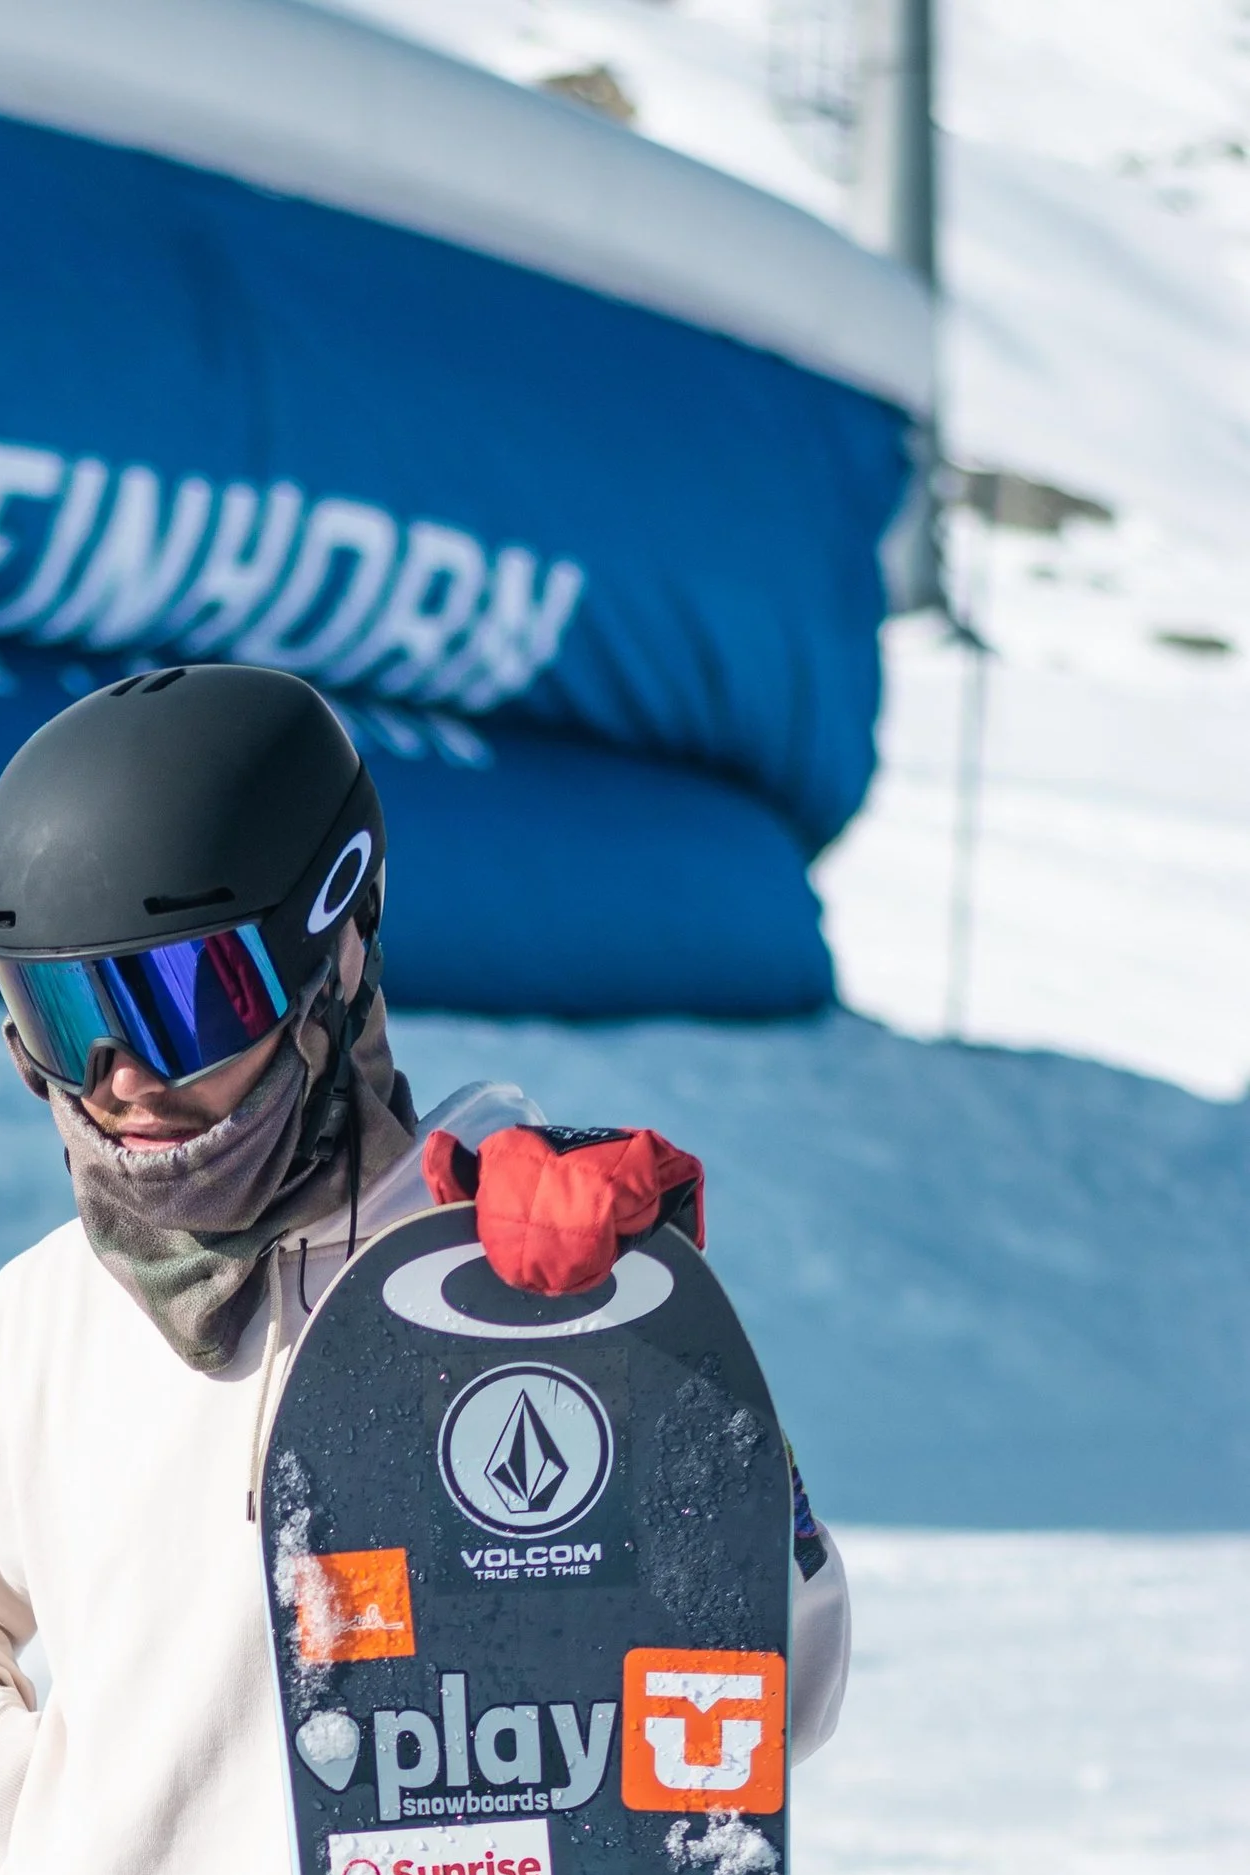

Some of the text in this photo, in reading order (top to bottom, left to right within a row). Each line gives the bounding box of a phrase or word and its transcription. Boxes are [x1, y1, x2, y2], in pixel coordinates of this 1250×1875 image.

[460, 1543, 602, 1569] VOLCOM
[473, 1564, 591, 1581] TRUE TO THIS
[374, 1672, 618, 1822] play
[403, 1788, 549, 1817] snowboards
